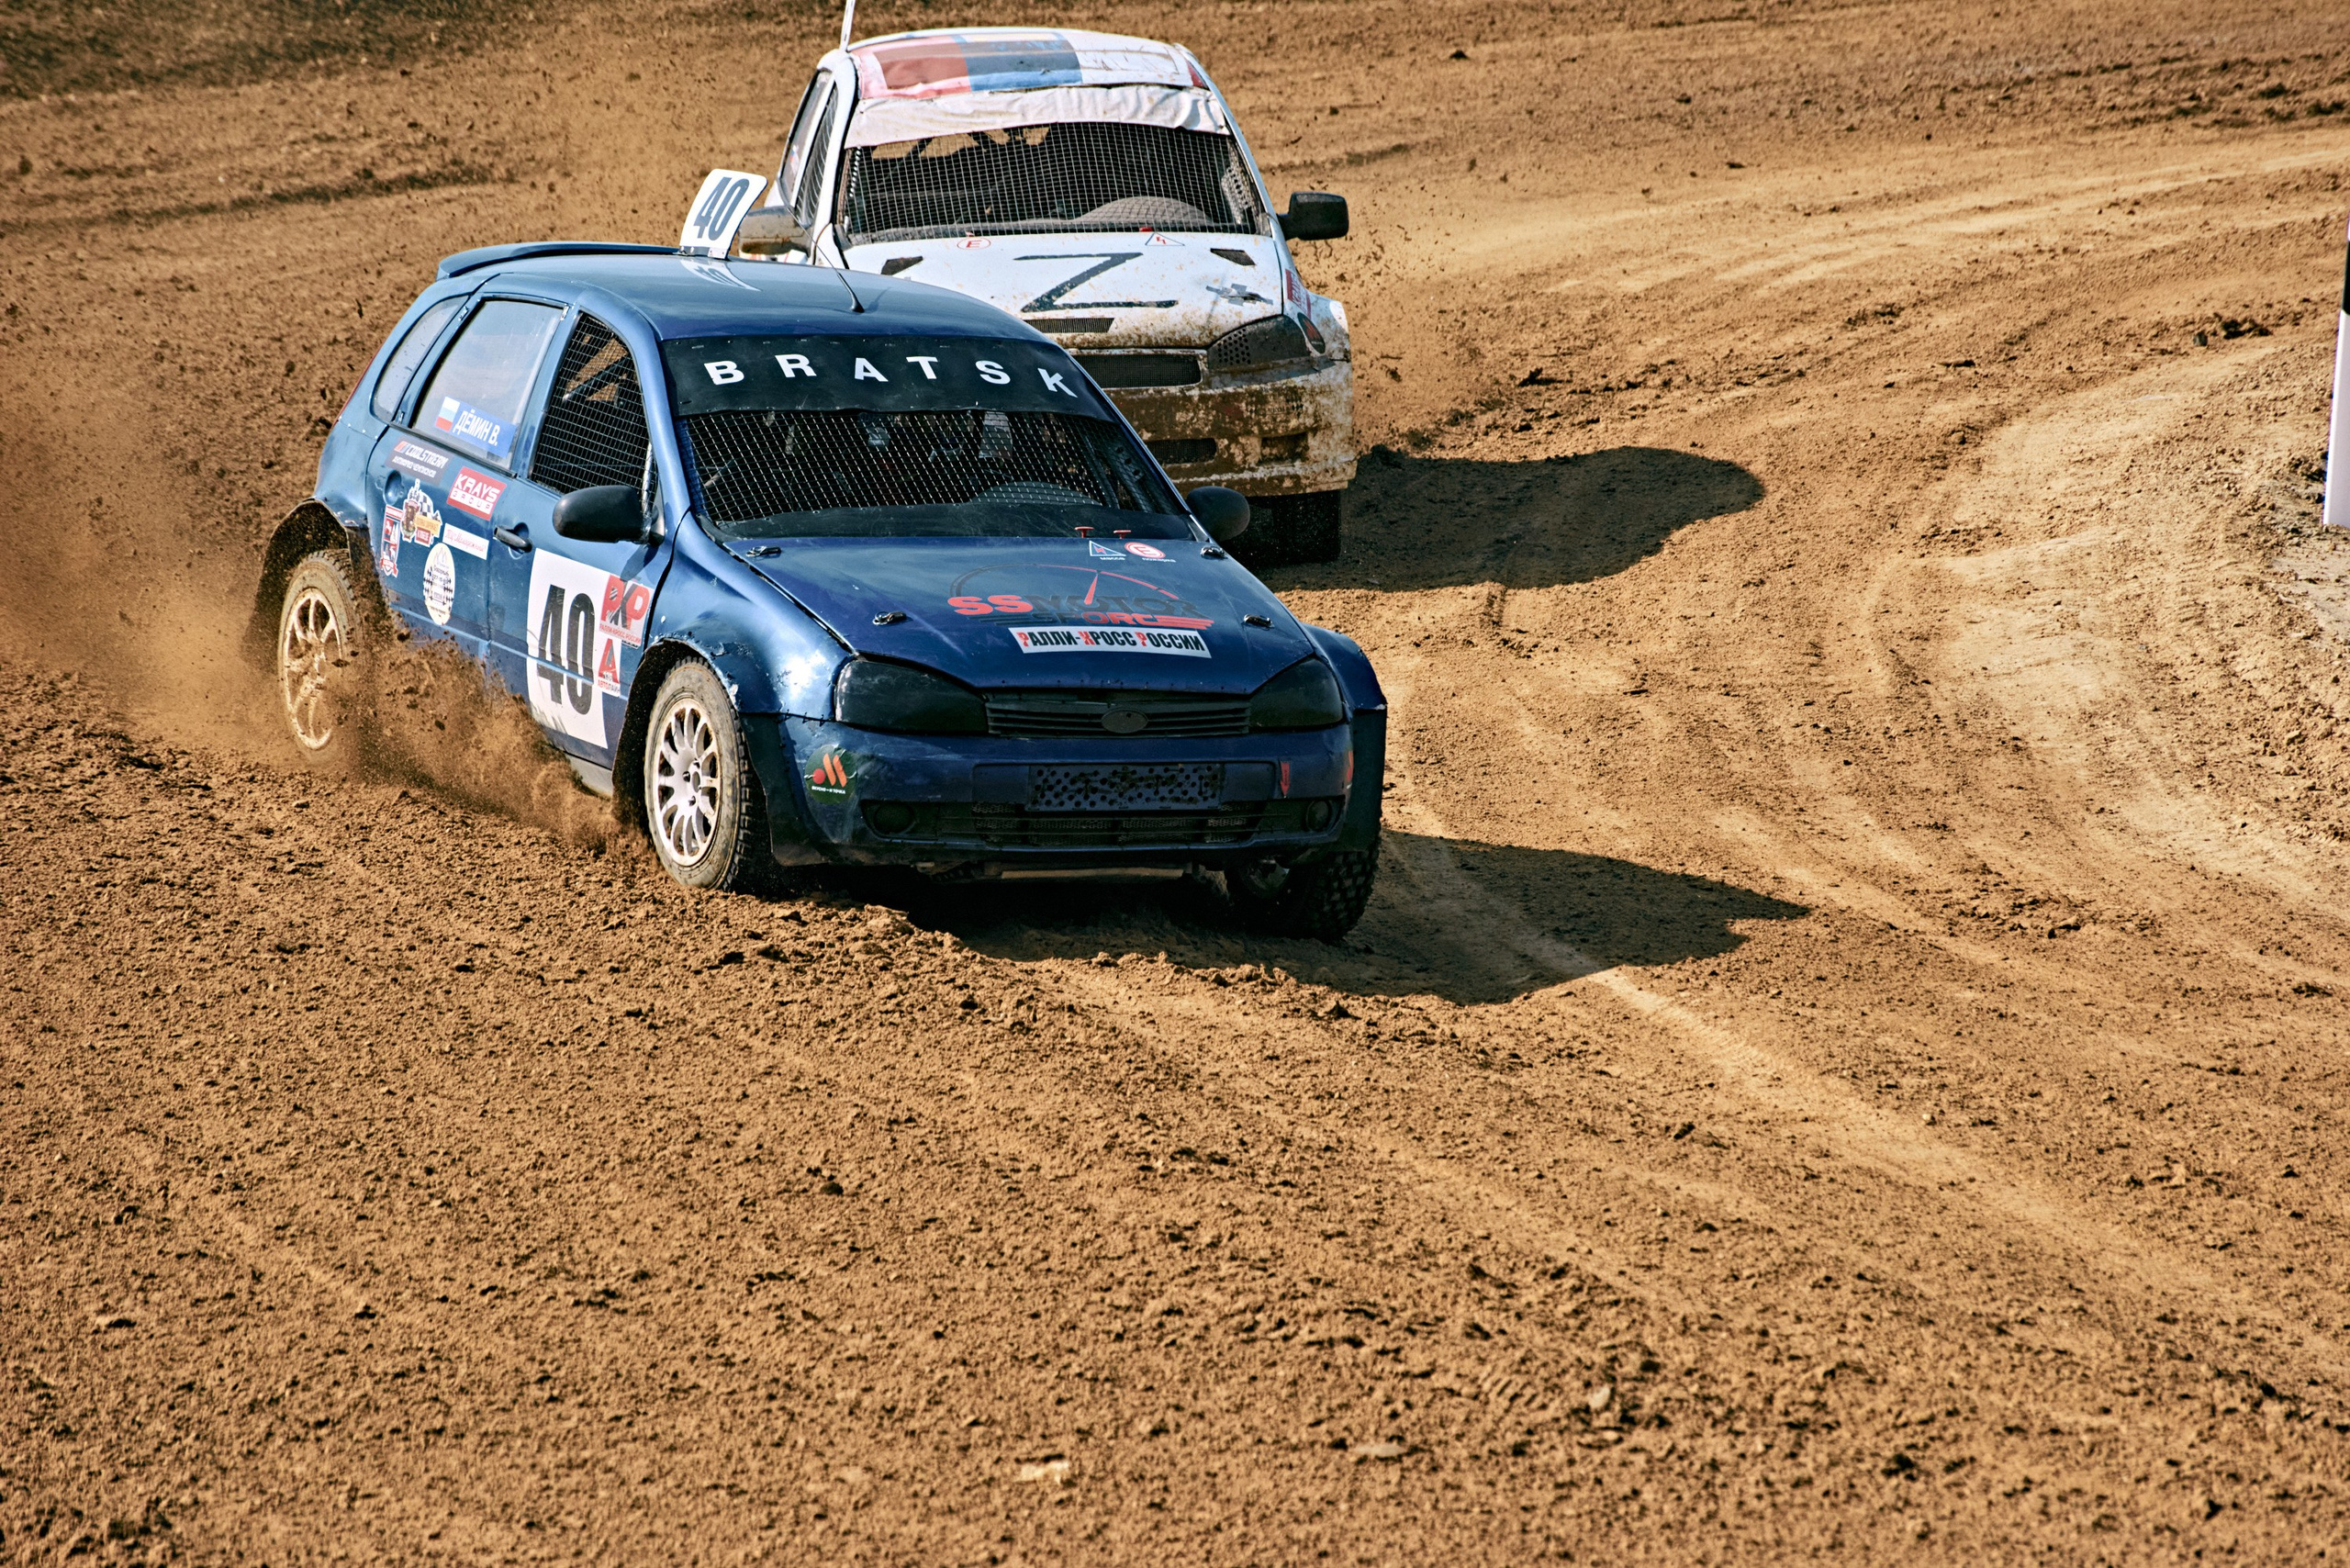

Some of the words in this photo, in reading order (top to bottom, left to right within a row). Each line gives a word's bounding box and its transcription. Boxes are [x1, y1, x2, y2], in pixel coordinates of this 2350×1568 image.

[693, 176, 750, 241] 40
[1013, 252, 1179, 312] Z
[704, 353, 1078, 398] BRATSK
[453, 409, 492, 442] ДЁМИН
[488, 424, 501, 446] В.
[453, 488, 490, 510] GROUP
[454, 474, 500, 502] KRAYS
[536, 584, 595, 715] 40
[1016, 630, 1136, 647] РАЛЛИ-КРОСС
[1135, 631, 1206, 652] РОССИИ
